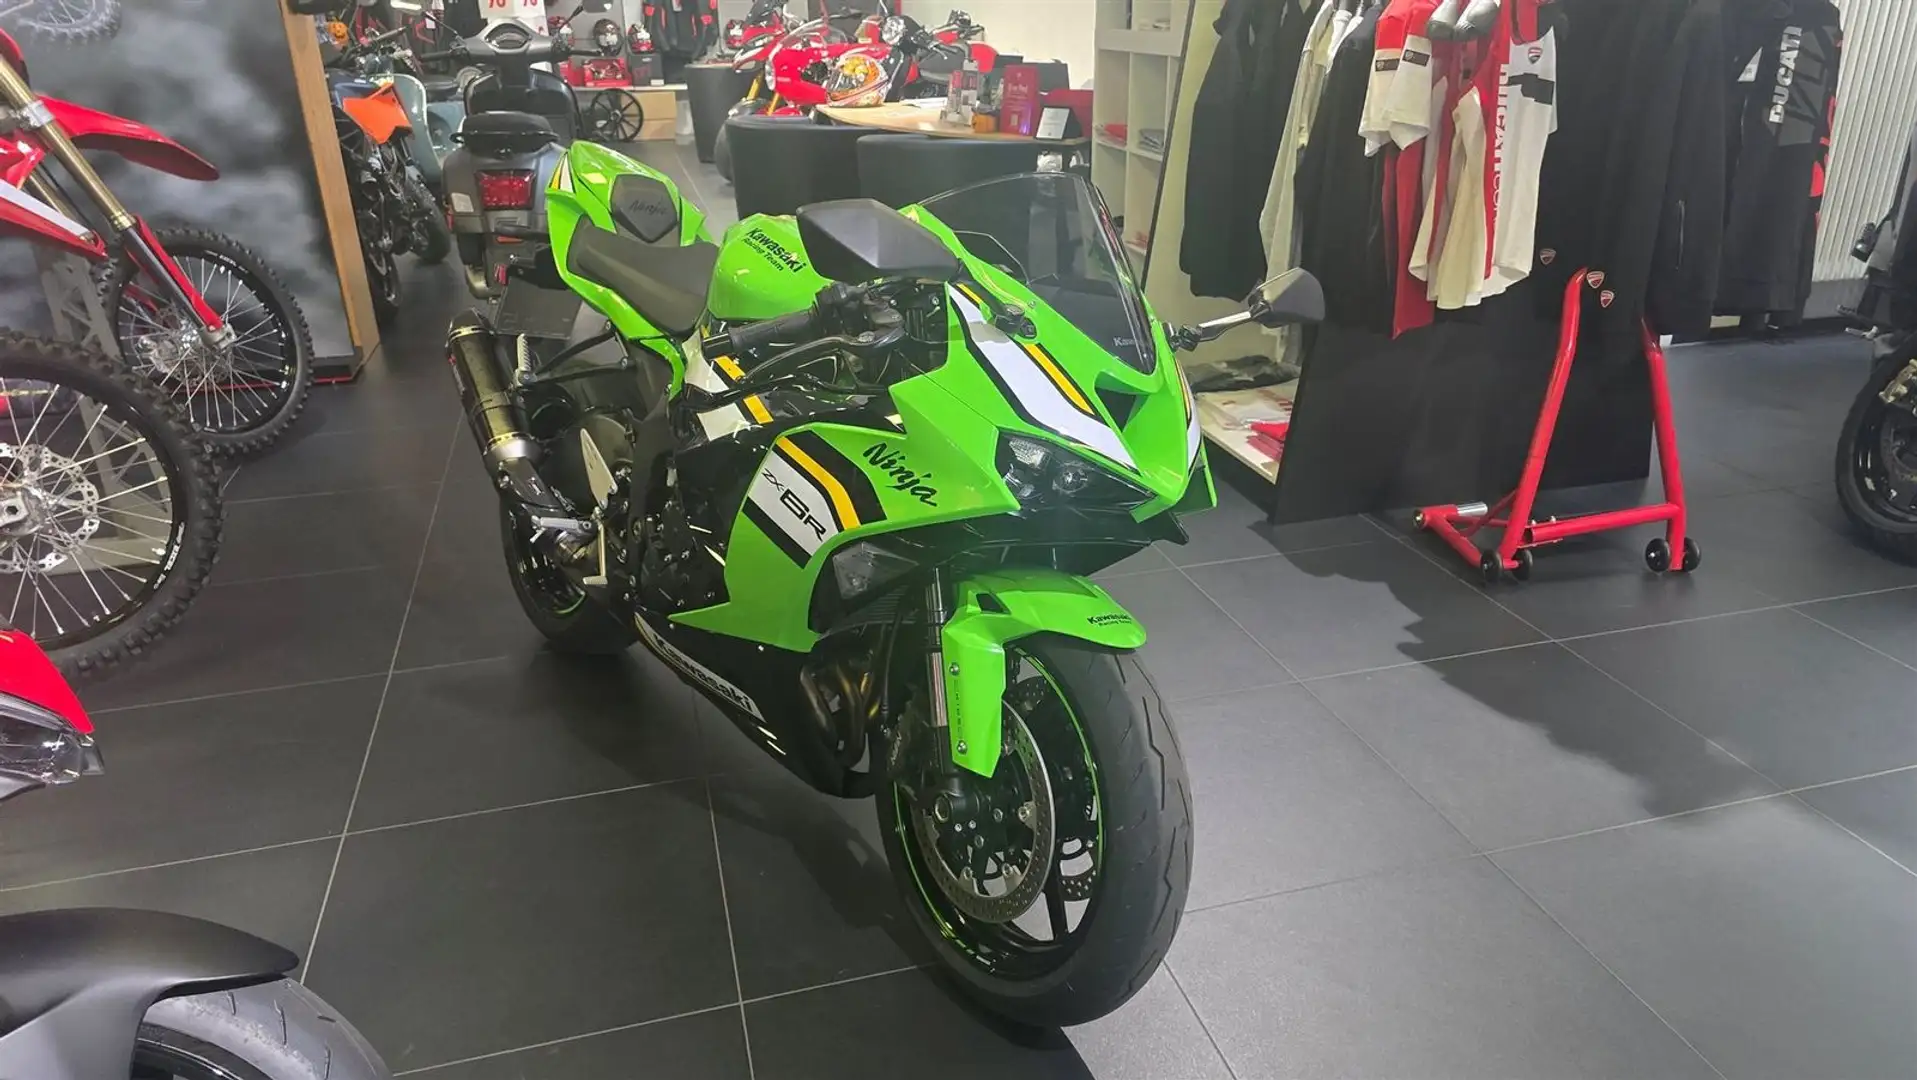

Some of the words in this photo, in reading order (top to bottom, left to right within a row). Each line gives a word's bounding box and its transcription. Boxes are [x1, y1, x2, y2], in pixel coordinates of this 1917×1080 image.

[1769, 26, 1802, 123] DUCATI
[746, 227, 807, 273] Kawasaki
[763, 251, 785, 272] Team
[863, 442, 938, 507] Ninja
[1086, 614, 1132, 625] Kawasaki
[652, 632, 754, 713] Kawasaki
